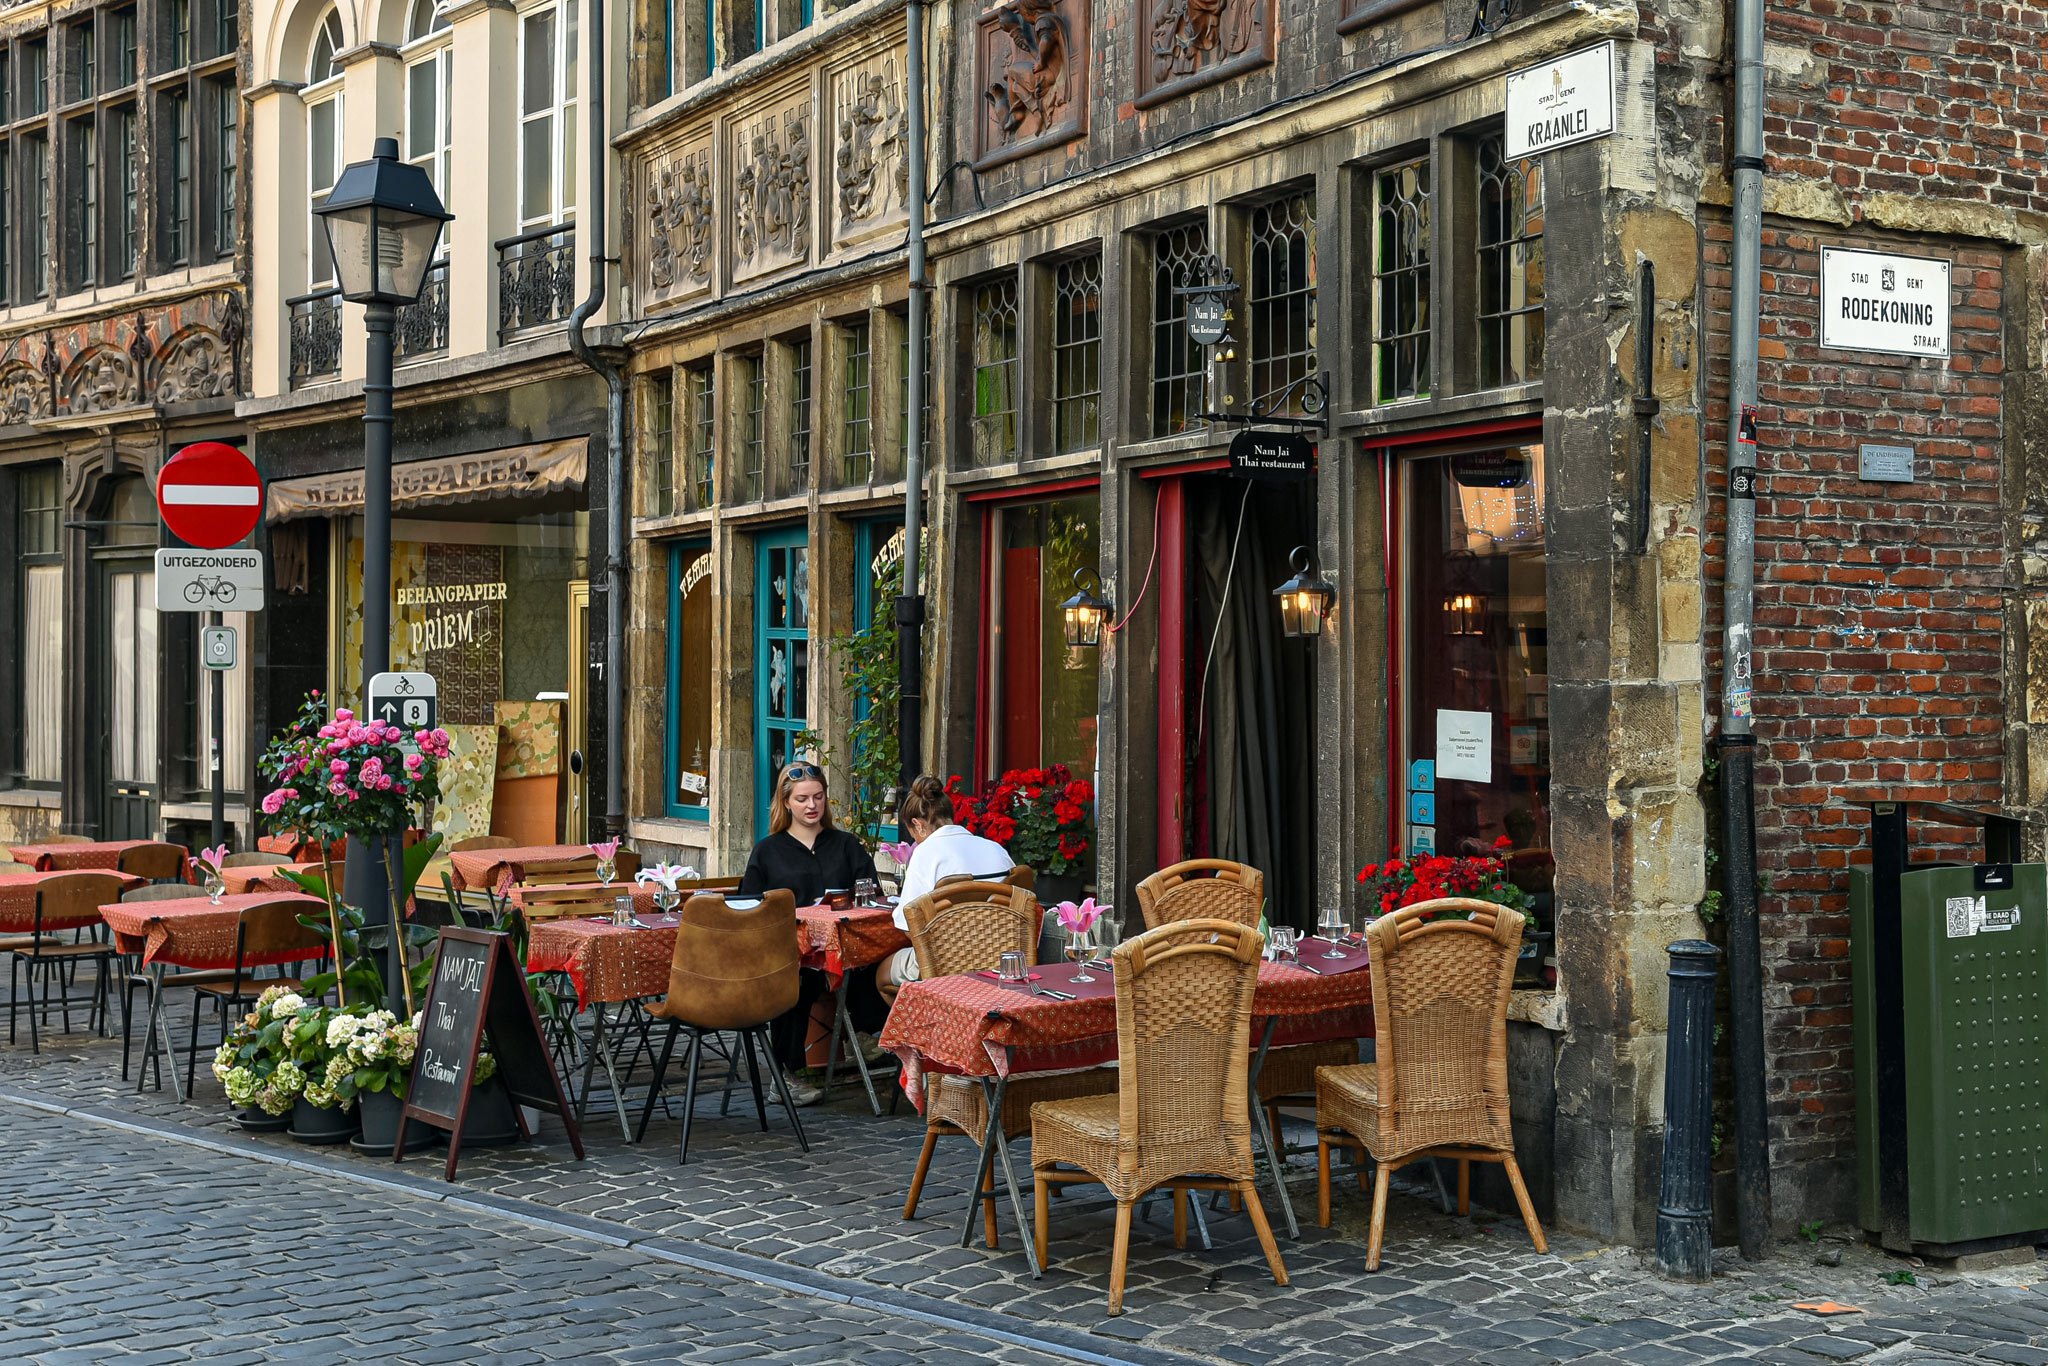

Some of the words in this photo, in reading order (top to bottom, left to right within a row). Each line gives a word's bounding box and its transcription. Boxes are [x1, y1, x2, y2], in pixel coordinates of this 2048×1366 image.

[1538, 94, 1555, 105] STAD
[1559, 86, 1576, 98] GENT
[1528, 108, 1588, 148] KRAANLEI
[1851, 272, 1869, 284] STAD
[1906, 277, 1924, 289] GENT
[1195, 306, 1209, 319] Nam
[1210, 306, 1218, 322] Jai
[1841, 296, 1934, 326] RODEKONING
[1191, 324, 1200, 333] Thai
[1200, 325, 1222, 334] Restaurant
[1913, 334, 1941, 349] STRAAT
[1254, 444, 1276, 456] Nam
[1277, 445, 1290, 458] Jai
[1237, 454, 1259, 467] Thai
[1261, 459, 1306, 470] restaurant
[1470, 495, 1545, 529] OPEN
[163, 556, 257, 568] UITGEZONDERD
[397, 582, 507, 605] BEHANGPAPIER
[411, 705, 420, 720] 8
[1992, 911, 2010, 919] DAAD
[440, 956, 465, 983] NAM
[460, 958, 485, 993] JAI
[438, 1002, 457, 1031] Thai
